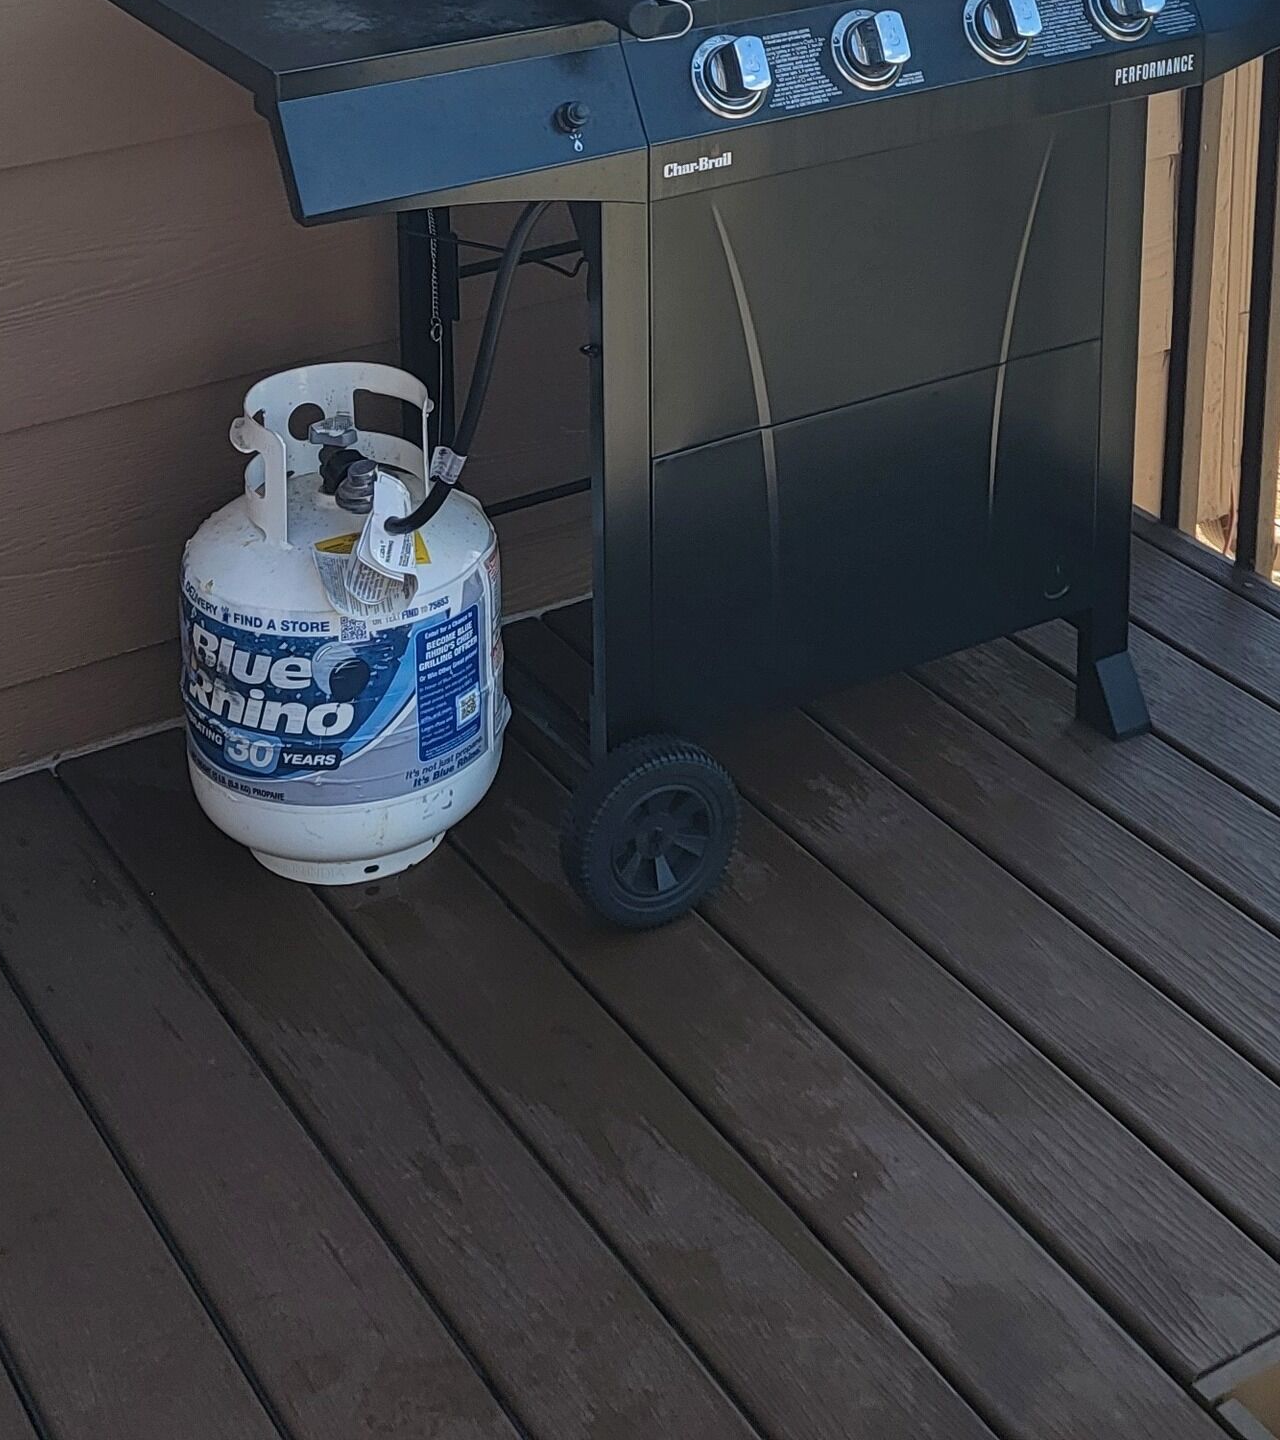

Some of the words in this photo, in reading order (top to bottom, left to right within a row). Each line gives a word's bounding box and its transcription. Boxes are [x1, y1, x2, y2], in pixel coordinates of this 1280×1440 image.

[1114, 54, 1195, 87] PERFORMANCE
[663, 152, 732, 179] Char-Broil
[185, 581, 219, 616] DELIVERY
[233, 613, 263, 629] FIND
[266, 619, 277, 631] A
[280, 620, 330, 633] STORE
[426, 631, 457, 651] BECOME
[457, 620, 473, 637] BLUE
[192, 623, 313, 690] Blue
[419, 652, 453, 672] GRILLING
[425, 641, 455, 661] RHINO'S
[189, 668, 355, 737] Rhino
[227, 737, 274, 768] 30
[282, 752, 337, 766] YEARS
[405, 768, 420, 781] It's
[422, 761, 438, 775] not
[413, 775, 430, 788] It's
[432, 763, 455, 781] Blue
[252, 786, 285, 801] PROPANE
